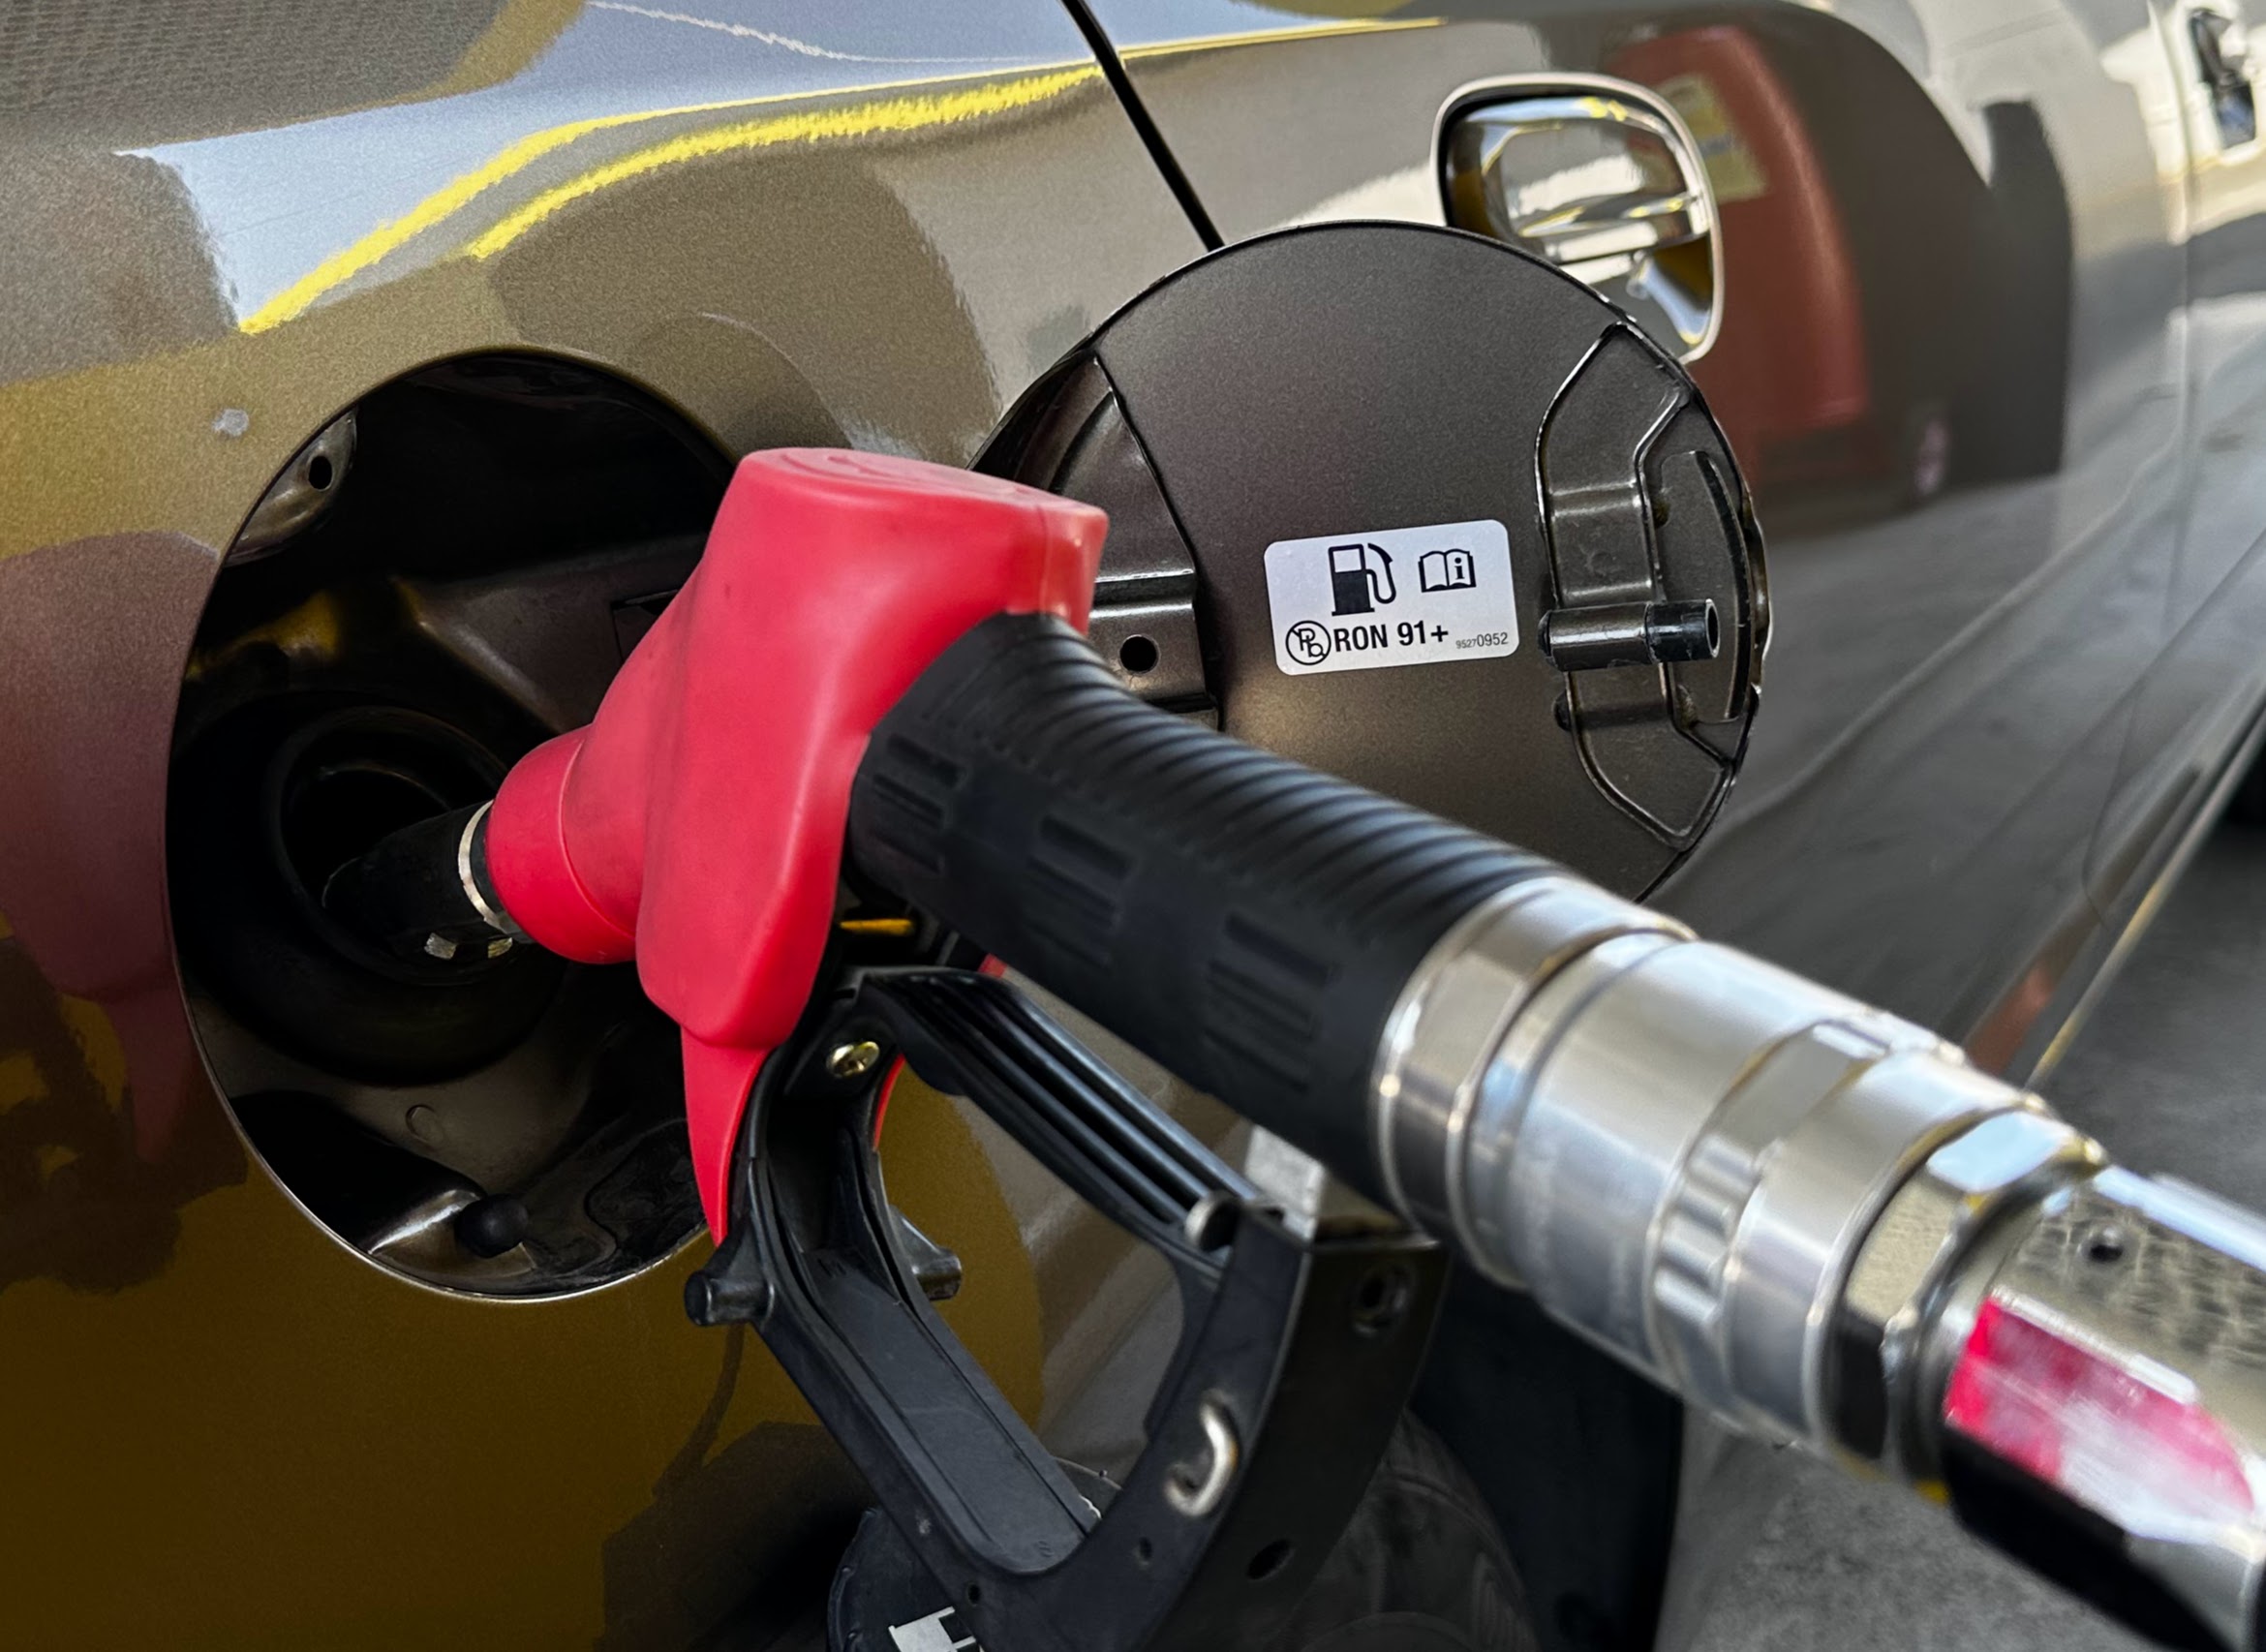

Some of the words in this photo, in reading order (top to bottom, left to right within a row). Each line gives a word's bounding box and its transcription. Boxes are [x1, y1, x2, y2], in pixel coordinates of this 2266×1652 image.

[1333, 624, 1388, 653] RON
[1397, 620, 1449, 646] 91+
[1455, 631, 1509, 650] 95270952
